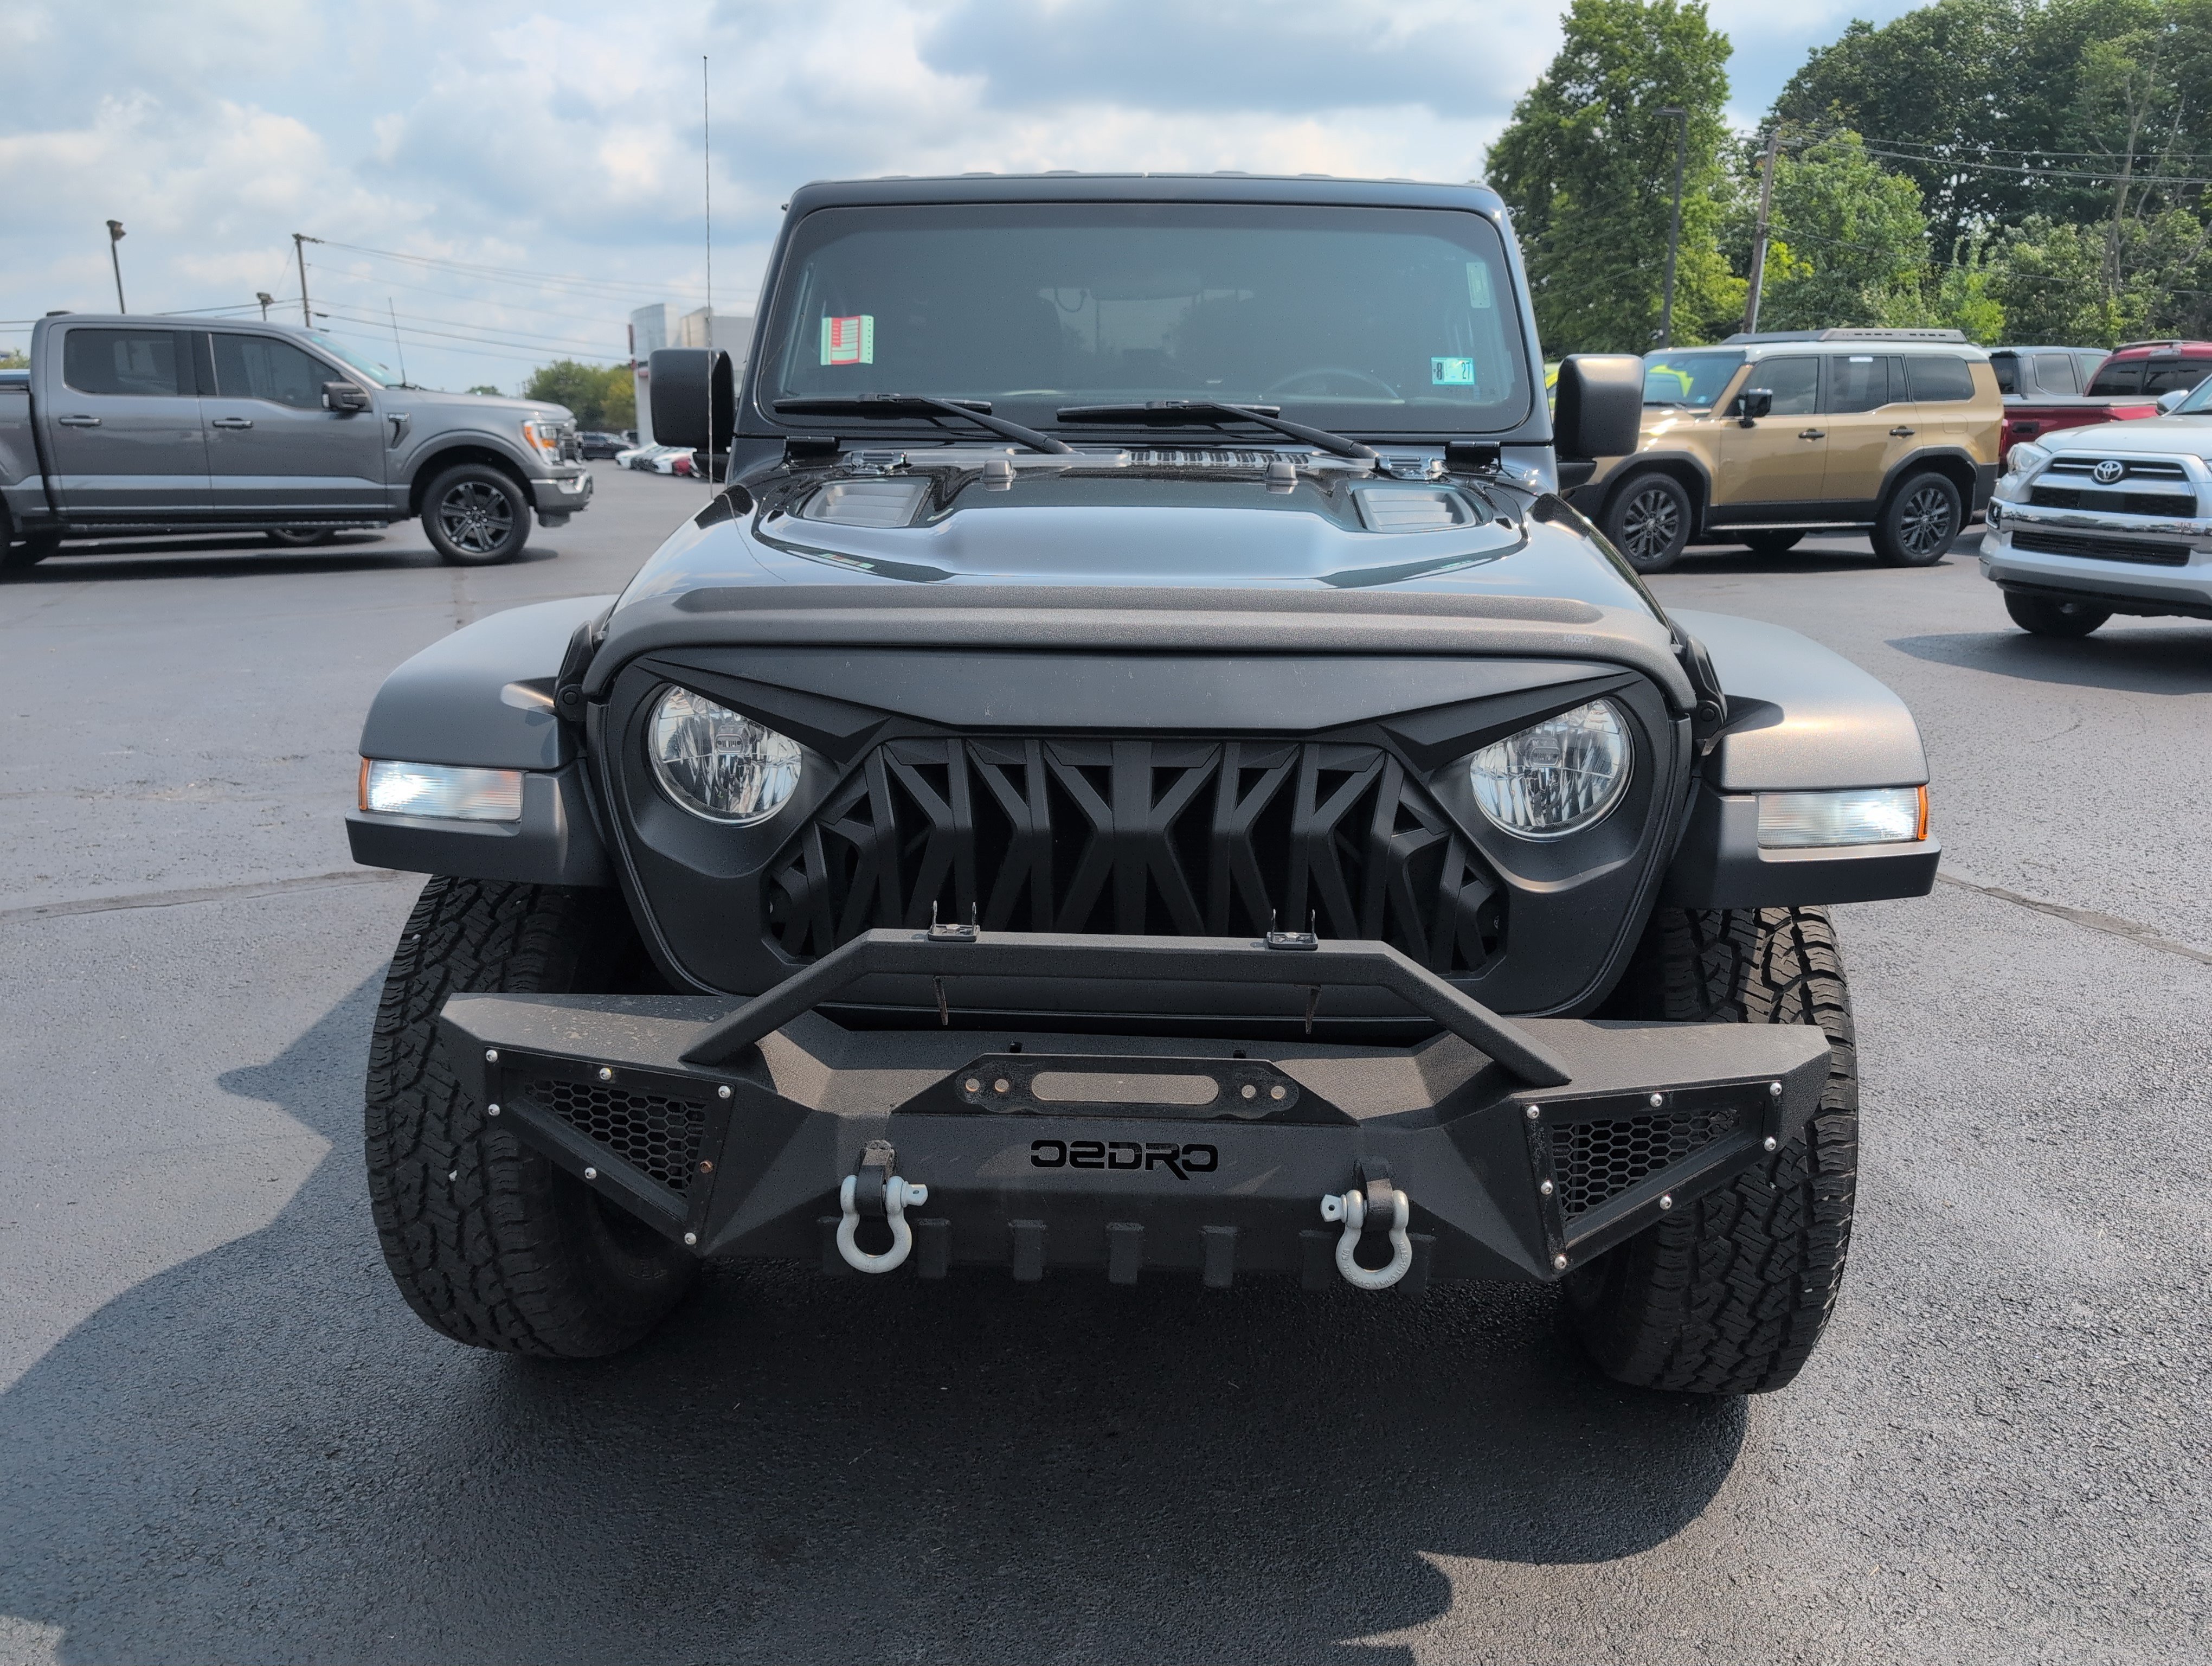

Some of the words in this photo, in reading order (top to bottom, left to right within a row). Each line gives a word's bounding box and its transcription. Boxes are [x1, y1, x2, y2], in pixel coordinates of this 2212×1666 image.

[1437, 362, 1443, 380] 8
[1461, 362, 1470, 380] 27
[1030, 1139, 1219, 1181] OEDRO
